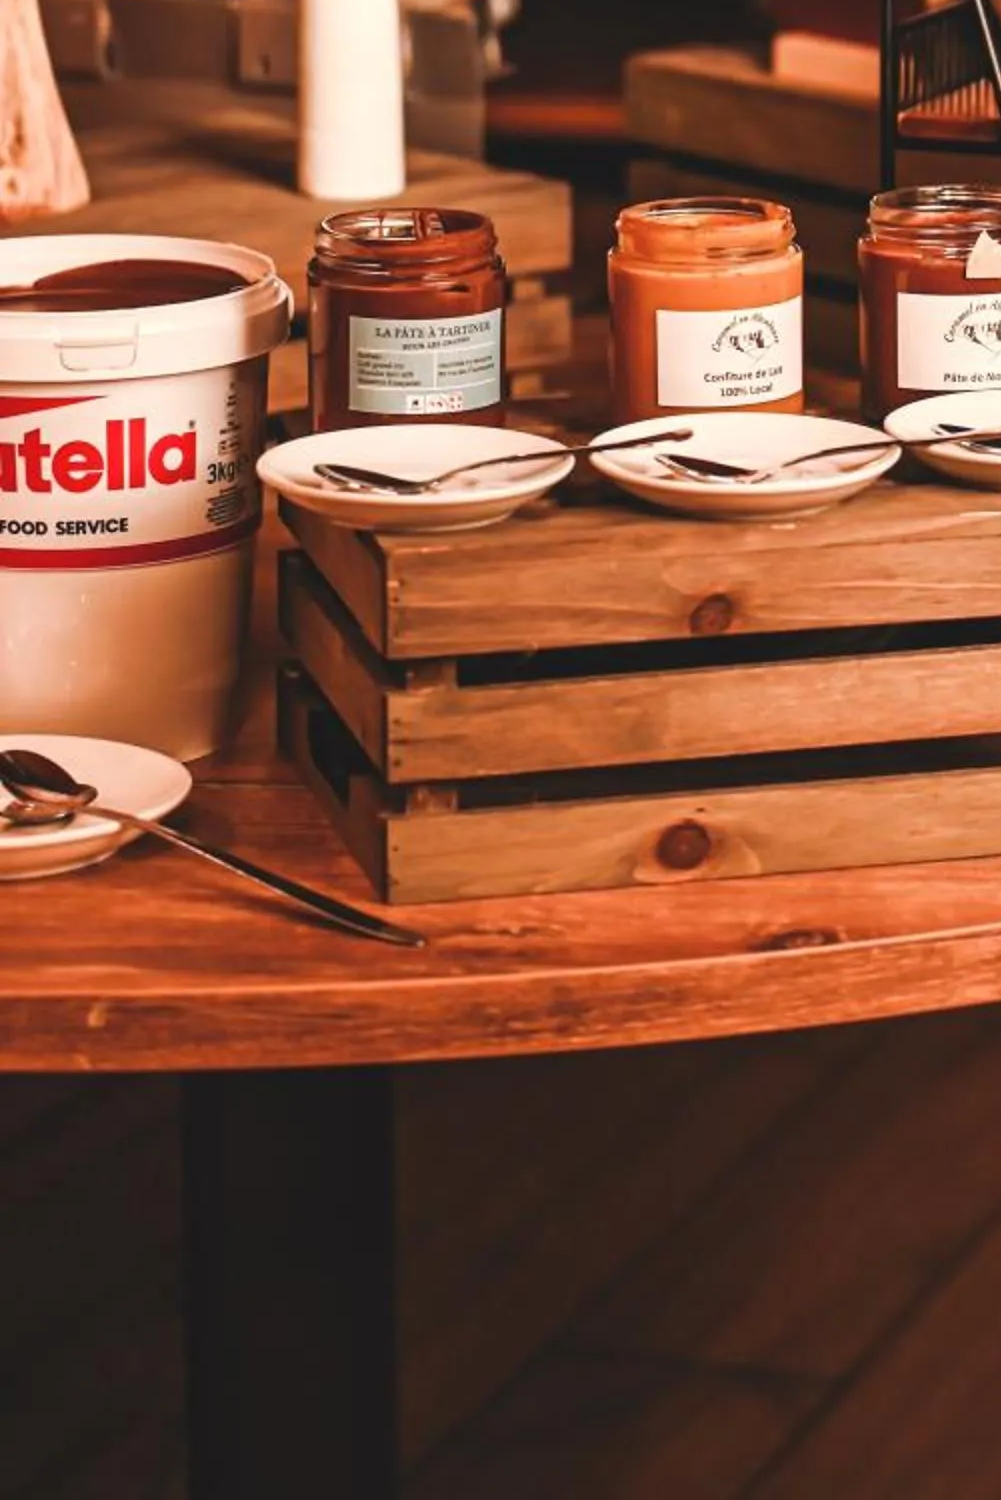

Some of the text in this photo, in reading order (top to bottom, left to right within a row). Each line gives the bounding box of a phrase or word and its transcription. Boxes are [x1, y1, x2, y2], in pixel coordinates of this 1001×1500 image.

[375, 327, 392, 338] LA
[703, 371, 753, 383] Confiture
[755, 369, 767, 379] de
[970, 372, 984, 382] de
[749, 382, 773, 395] Local
[55, 517, 128, 535] SERVICE
